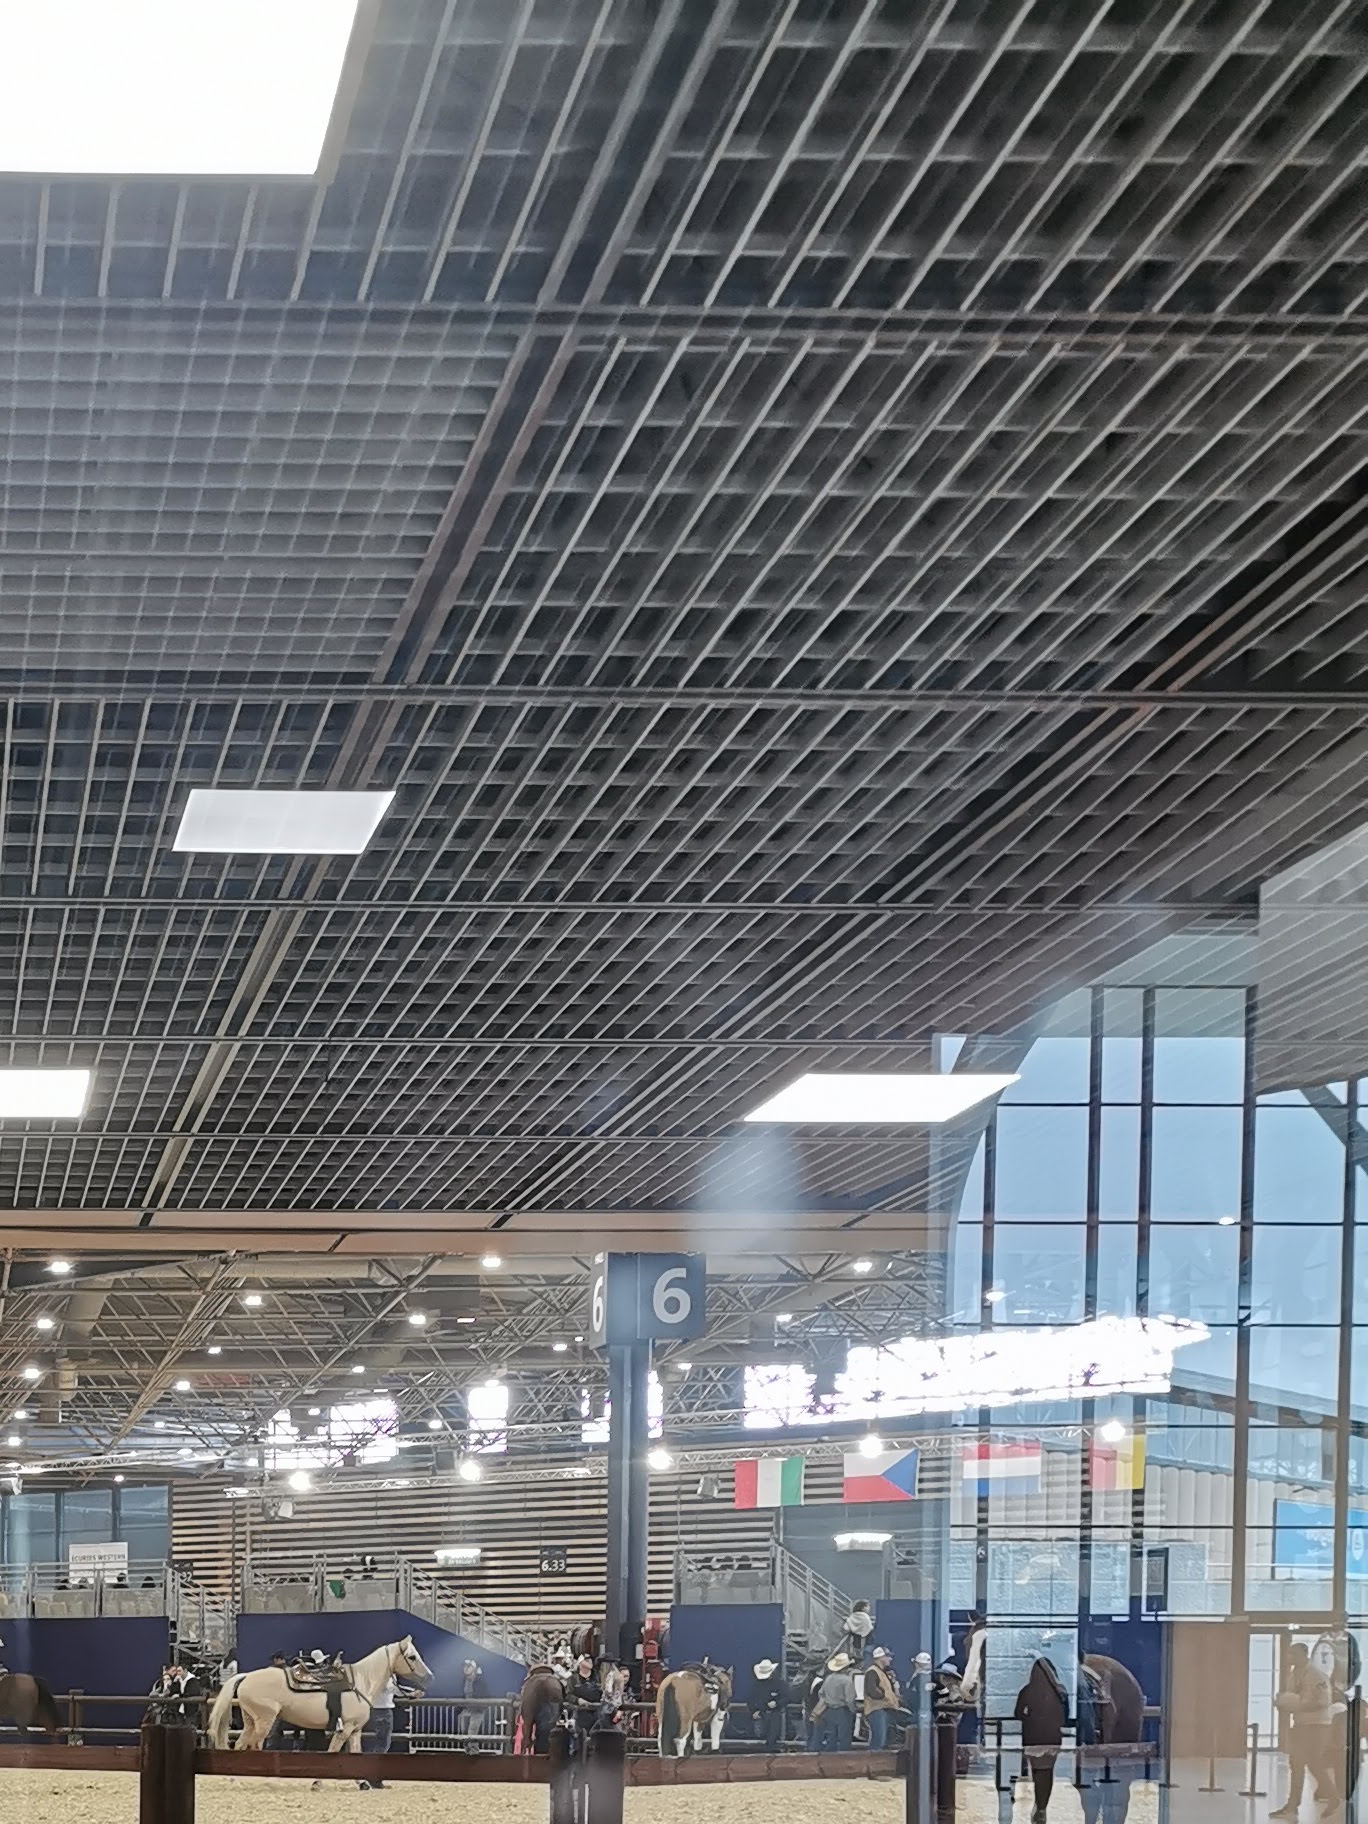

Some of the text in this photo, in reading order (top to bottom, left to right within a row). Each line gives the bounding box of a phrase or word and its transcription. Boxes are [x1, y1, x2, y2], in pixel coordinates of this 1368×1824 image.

[592, 1275, 604, 1333] 6
[652, 1267, 691, 1324] 6
[541, 1559, 566, 1572] 6.33
